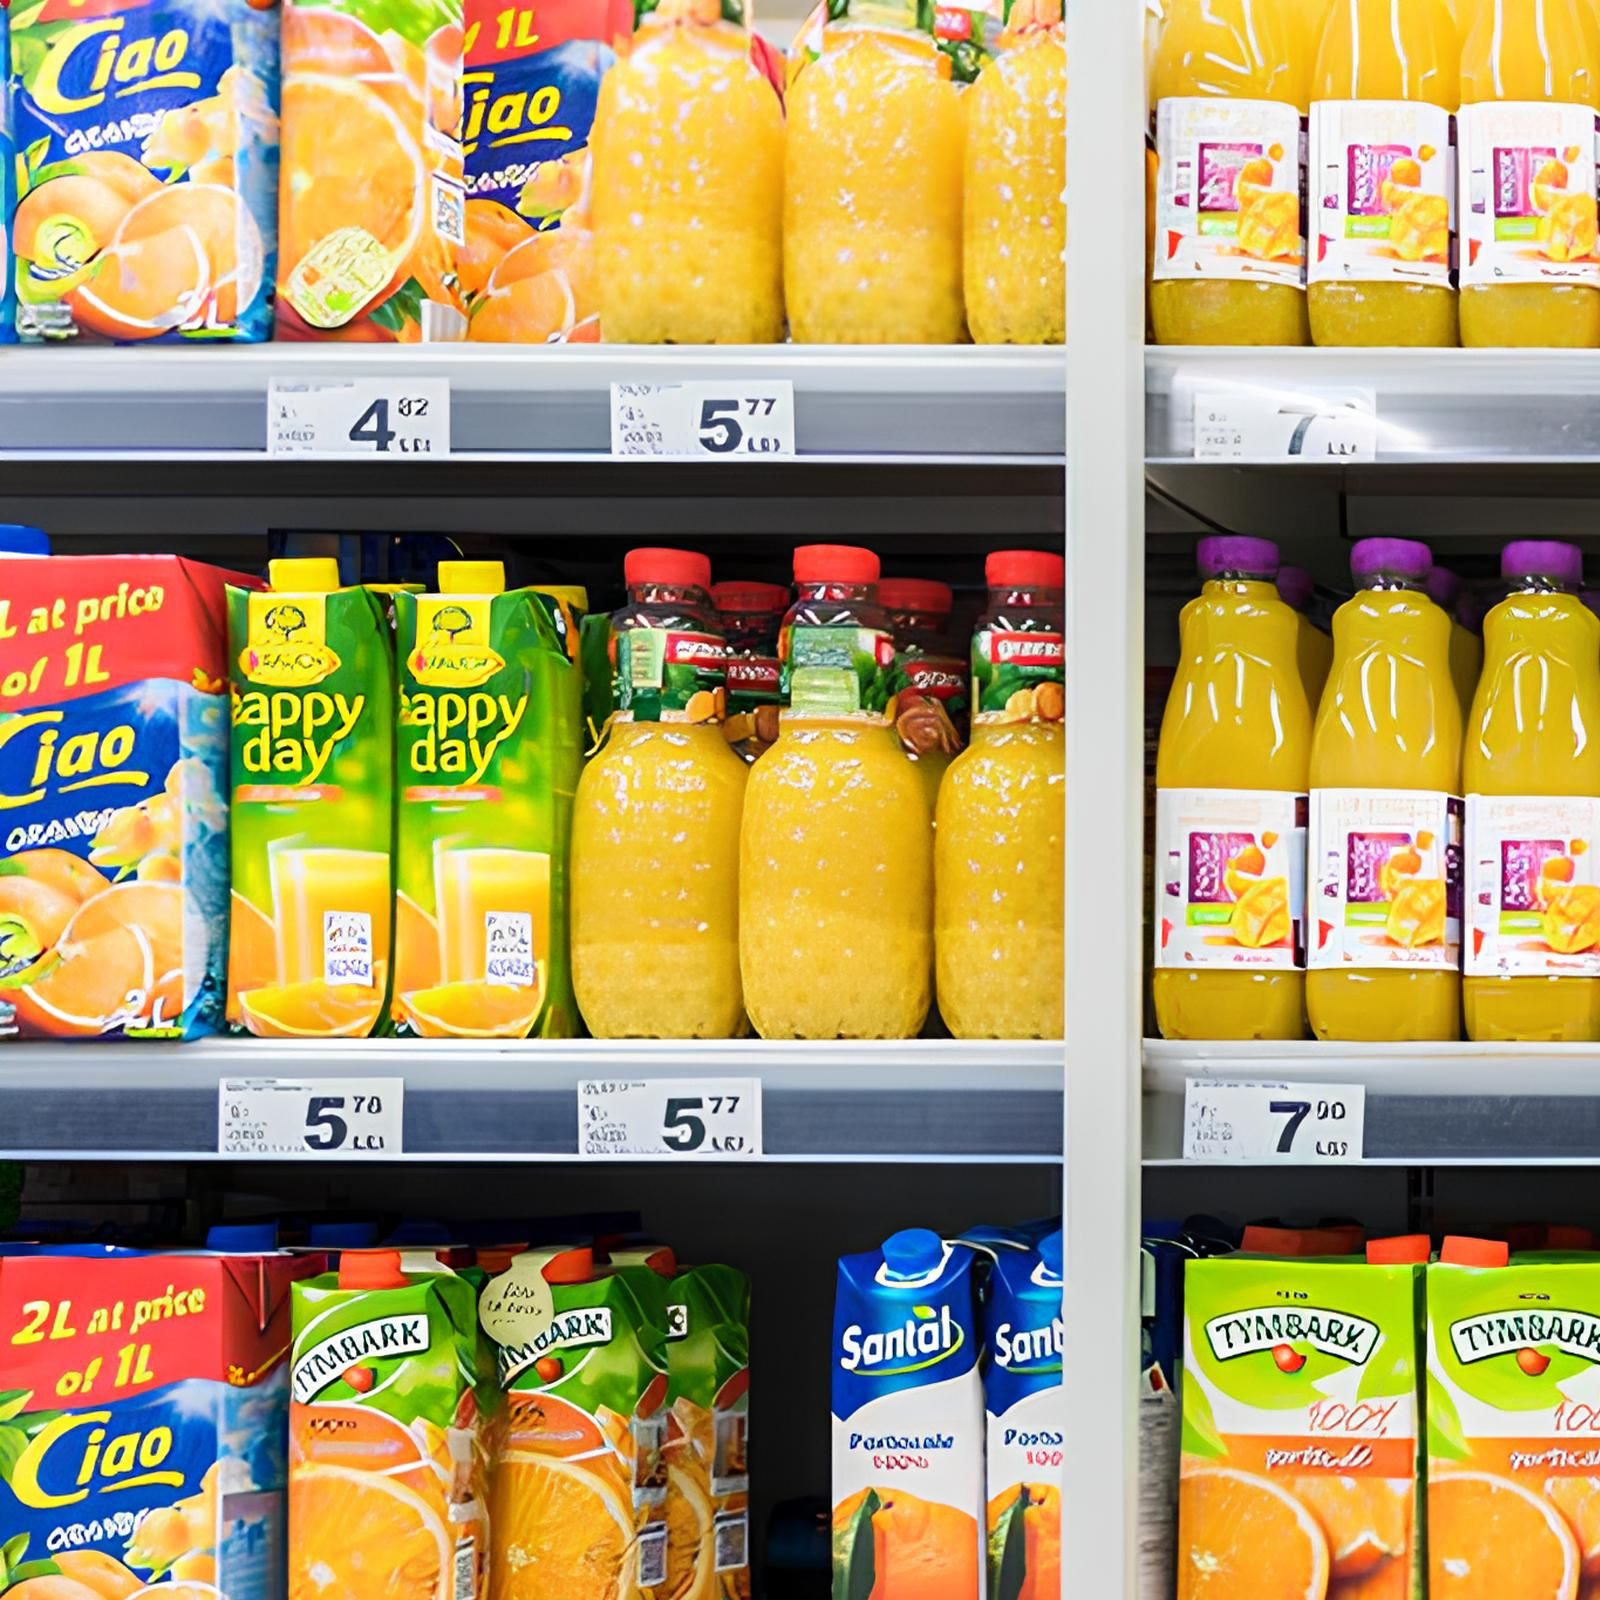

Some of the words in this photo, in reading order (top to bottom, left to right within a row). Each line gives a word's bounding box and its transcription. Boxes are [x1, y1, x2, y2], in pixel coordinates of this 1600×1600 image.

[34, 18, 190, 115] Ciao
[460, 73, 562, 153] iao
[350, 400, 396, 451] 4
[700, 400, 742, 452] 5
[746, 399, 777, 416] 77
[243, 729, 336, 783] day
[410, 730, 500, 783] day
[304, 1097, 347, 1150] 5
[661, 1097, 705, 1151] 5
[709, 1096, 740, 1114] 77
[1269, 1101, 1311, 1152] 7
[12, 1300, 77, 1345] 2L
[130, 1284, 207, 1334] price
[12, 1409, 172, 1509] Ciao
